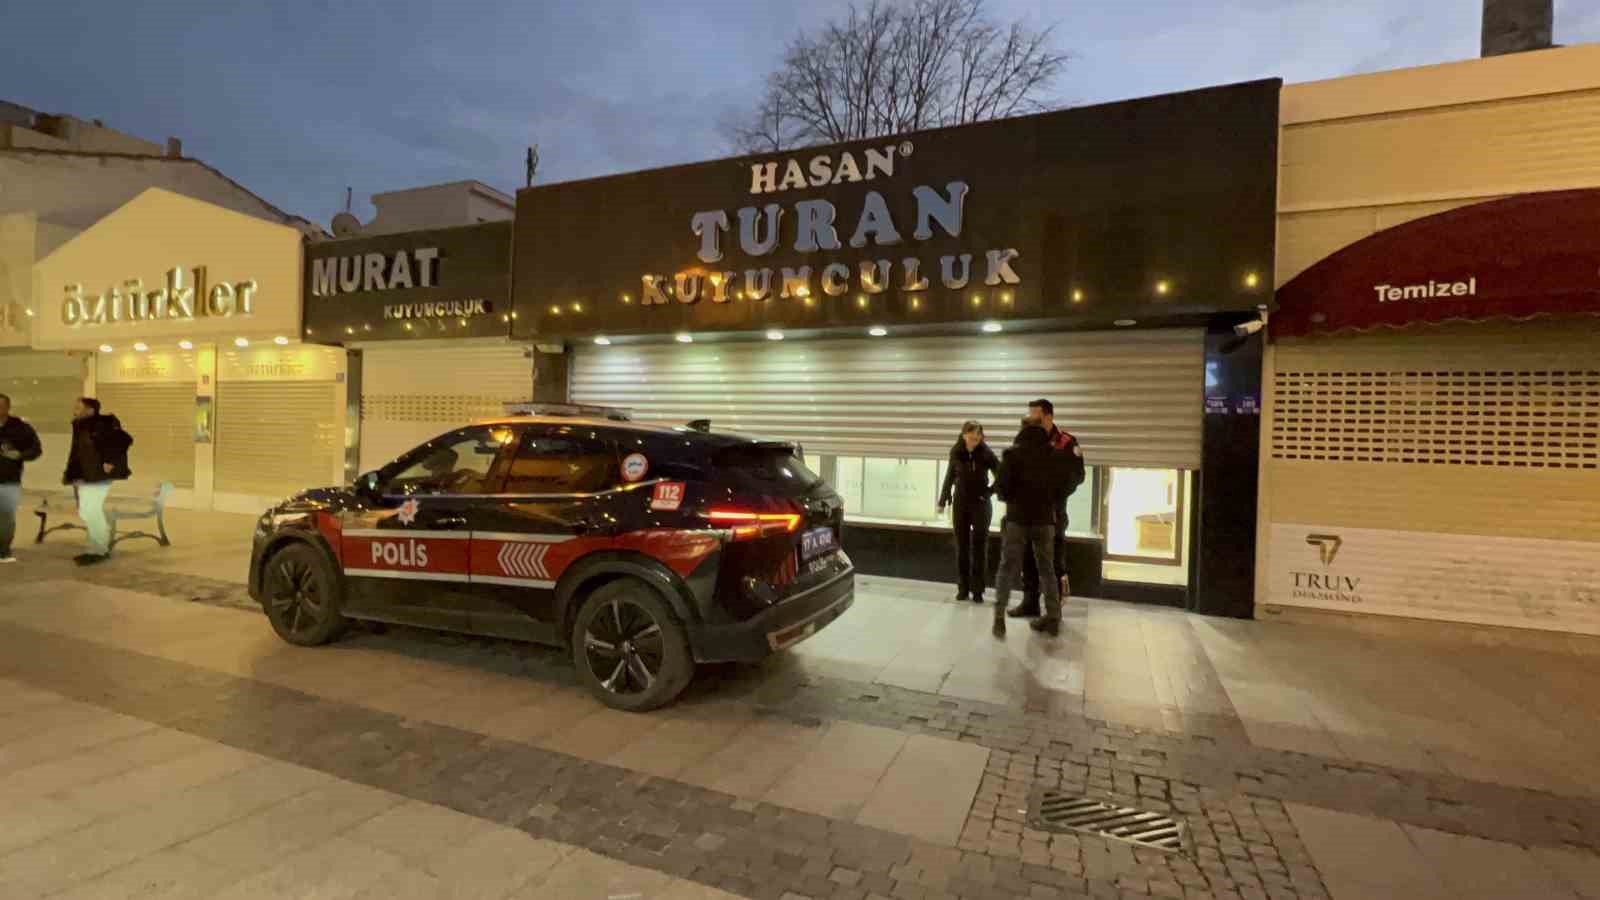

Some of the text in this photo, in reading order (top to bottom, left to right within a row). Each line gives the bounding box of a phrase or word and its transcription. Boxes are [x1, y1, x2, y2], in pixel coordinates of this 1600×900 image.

[691, 180, 970, 263] TURAN
[312, 247, 438, 297] MURAT
[640, 248, 1021, 305] KUYUMCULUK
[1374, 277, 1476, 302] Temizel
[62, 265, 257, 327] öztürkler
[659, 485, 679, 499] 112
[371, 540, 428, 567] POLİS
[1289, 571, 1361, 592] TRUV
